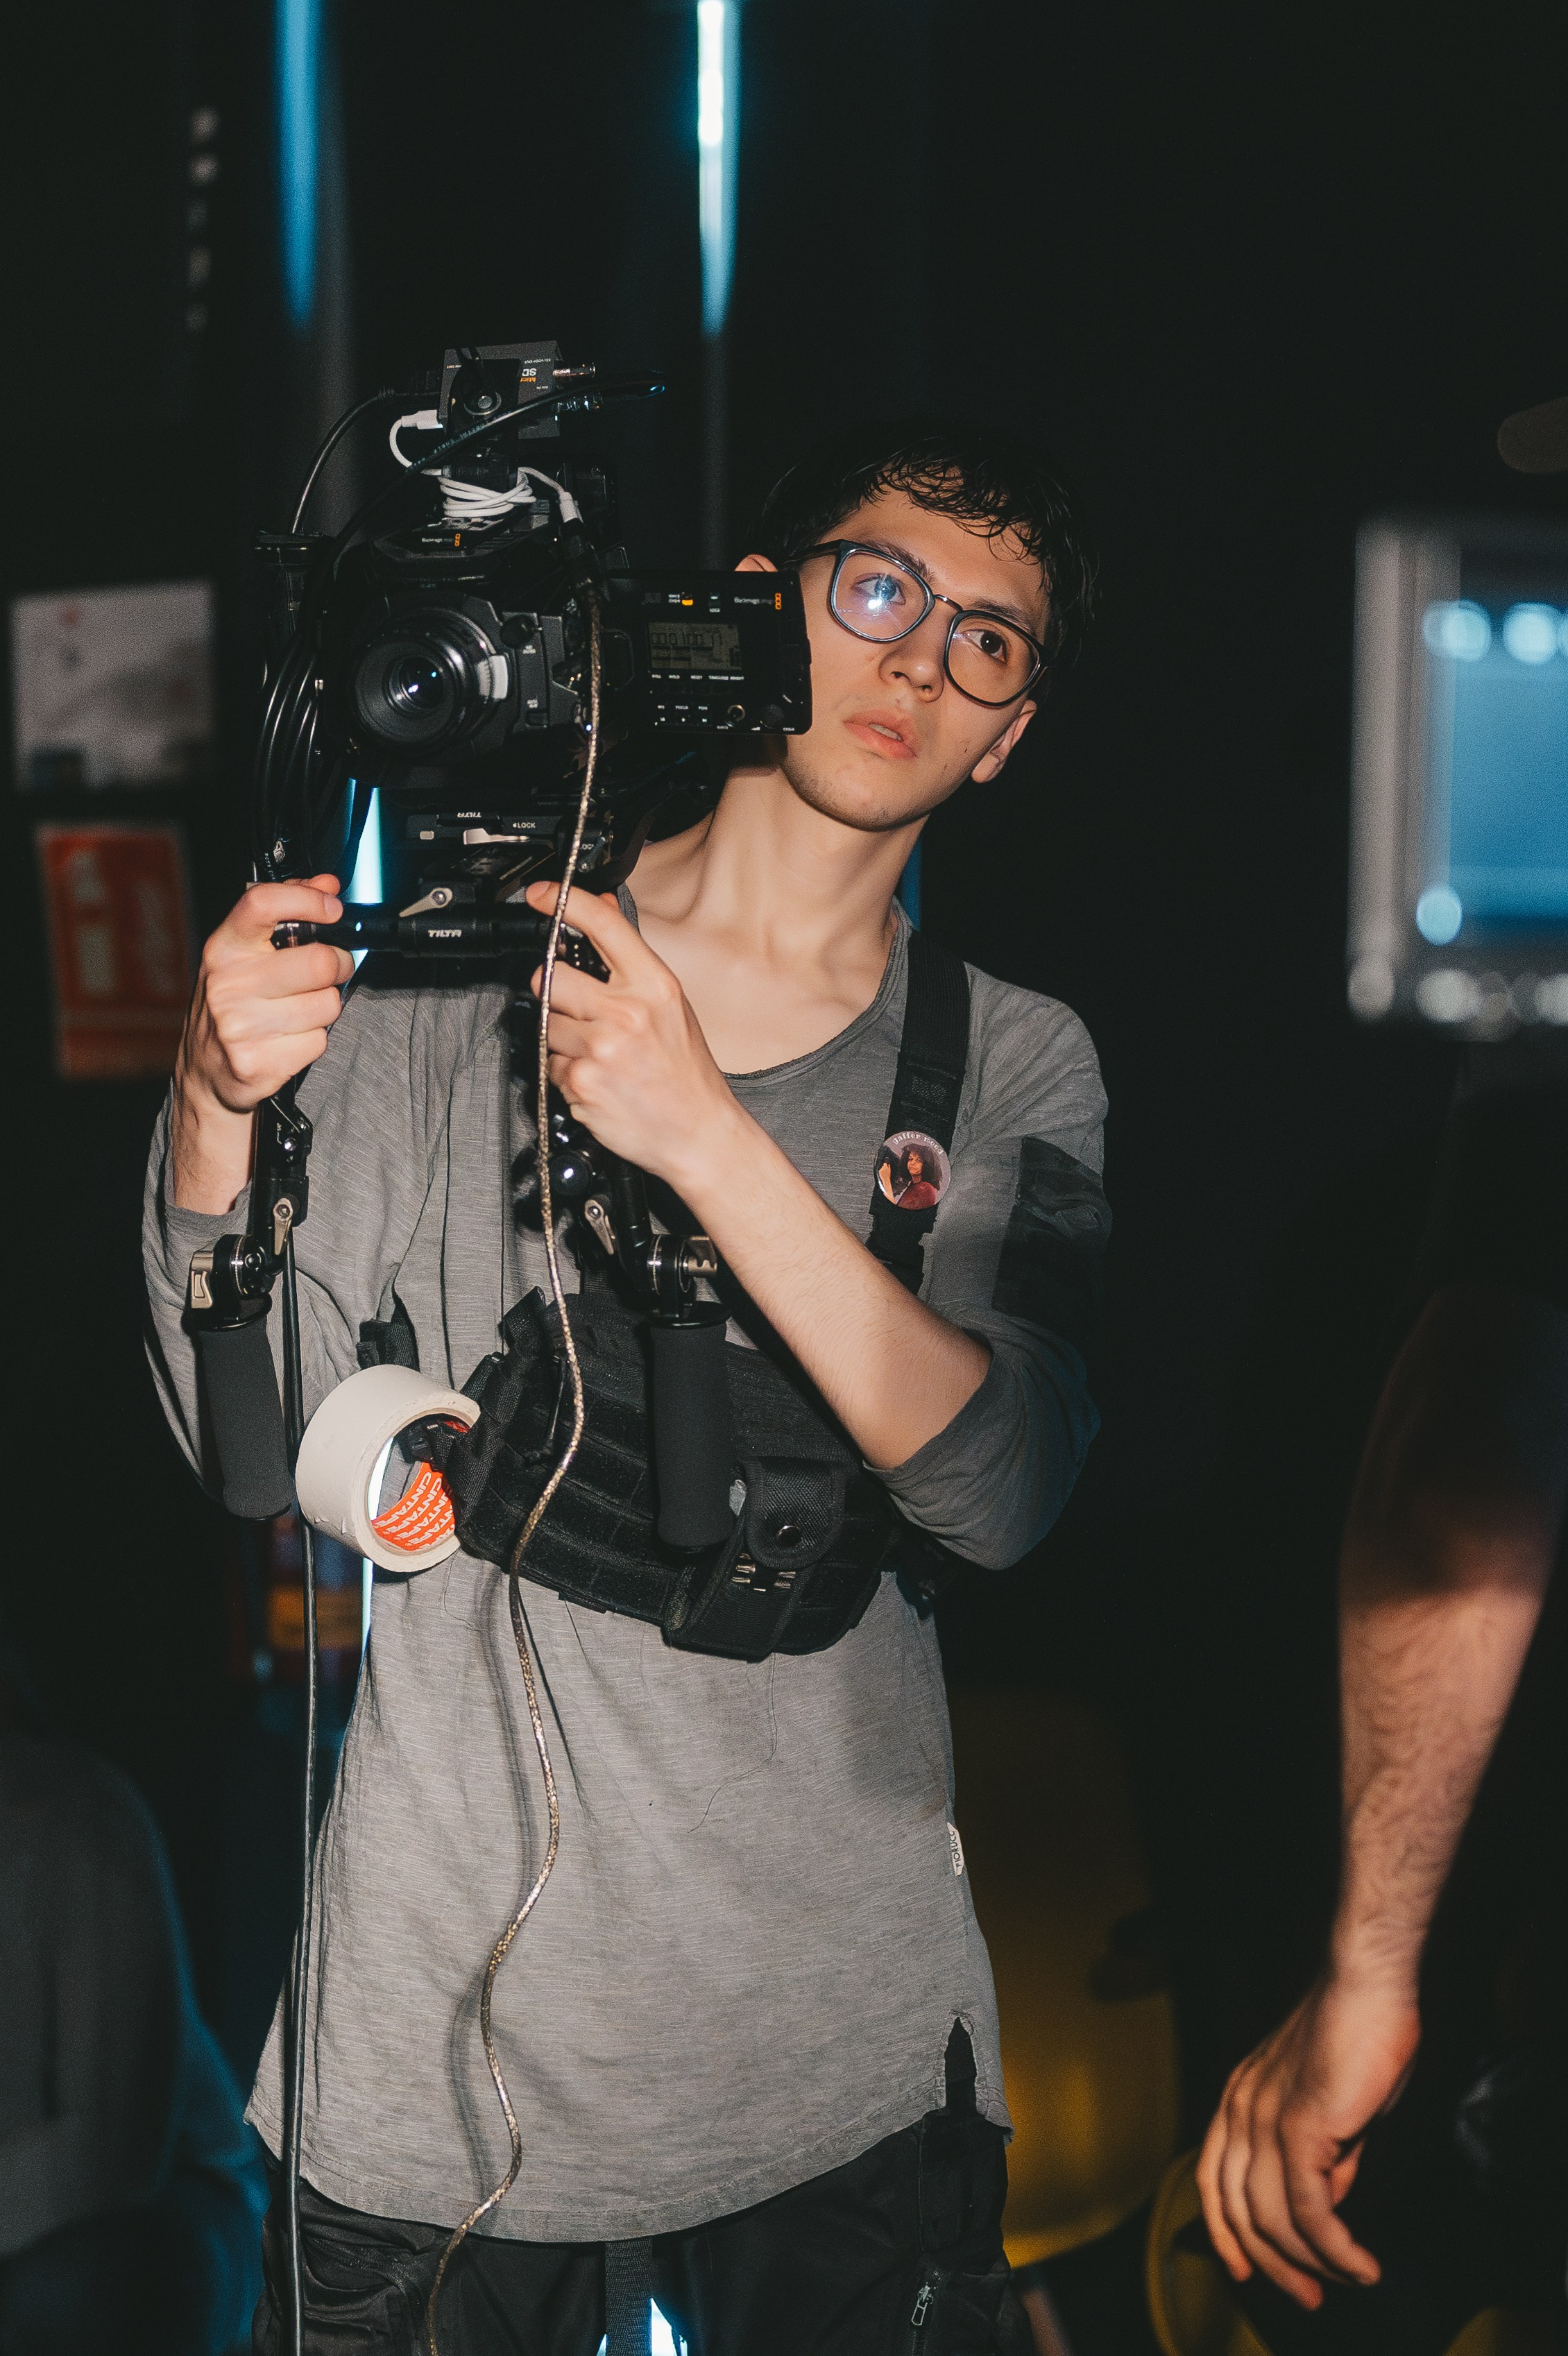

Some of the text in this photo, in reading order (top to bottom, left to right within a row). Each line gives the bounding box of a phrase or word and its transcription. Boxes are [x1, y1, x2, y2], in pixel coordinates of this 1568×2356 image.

[522, 368, 537, 377] SD
[893, 1133, 920, 1144] gaffer
[397, 1492, 448, 1539] INTAPE
